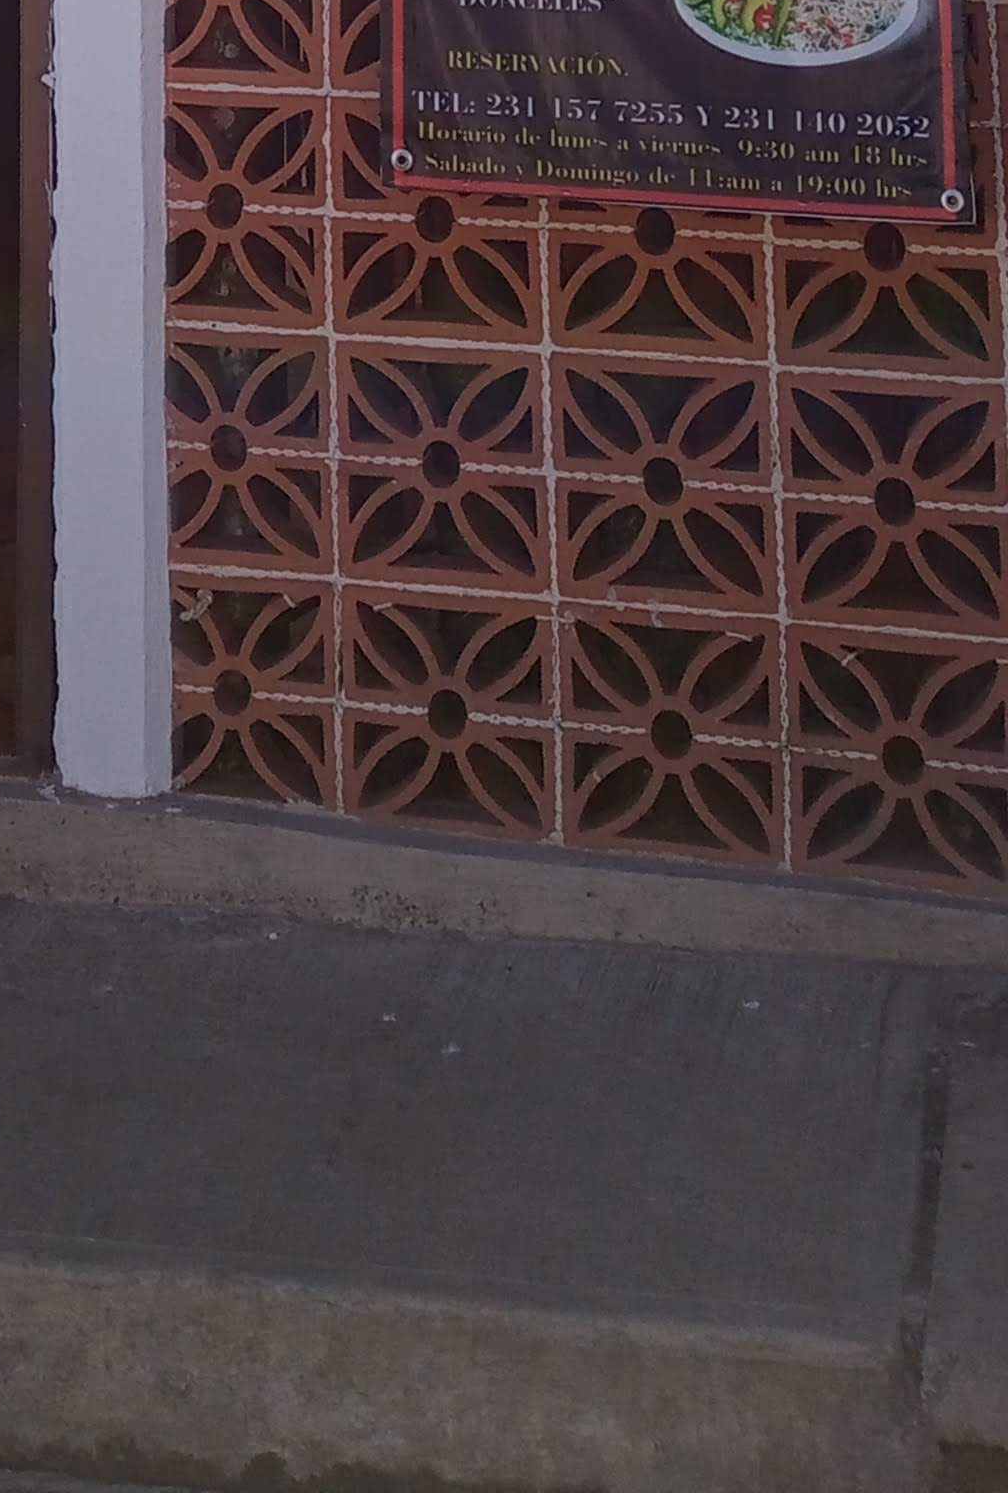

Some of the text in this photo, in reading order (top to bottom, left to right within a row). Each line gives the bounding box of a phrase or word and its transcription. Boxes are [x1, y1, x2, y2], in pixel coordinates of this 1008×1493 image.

[412, 90, 931, 139] TEL: 231 157 7255 Y 231 140 2052
[418, 121, 928, 168] Horario de lunes a viernes 9:30 am 18 hrs
[424, 155, 913, 199] Sabado y Domingo de 11:am a 19:00 hrs
